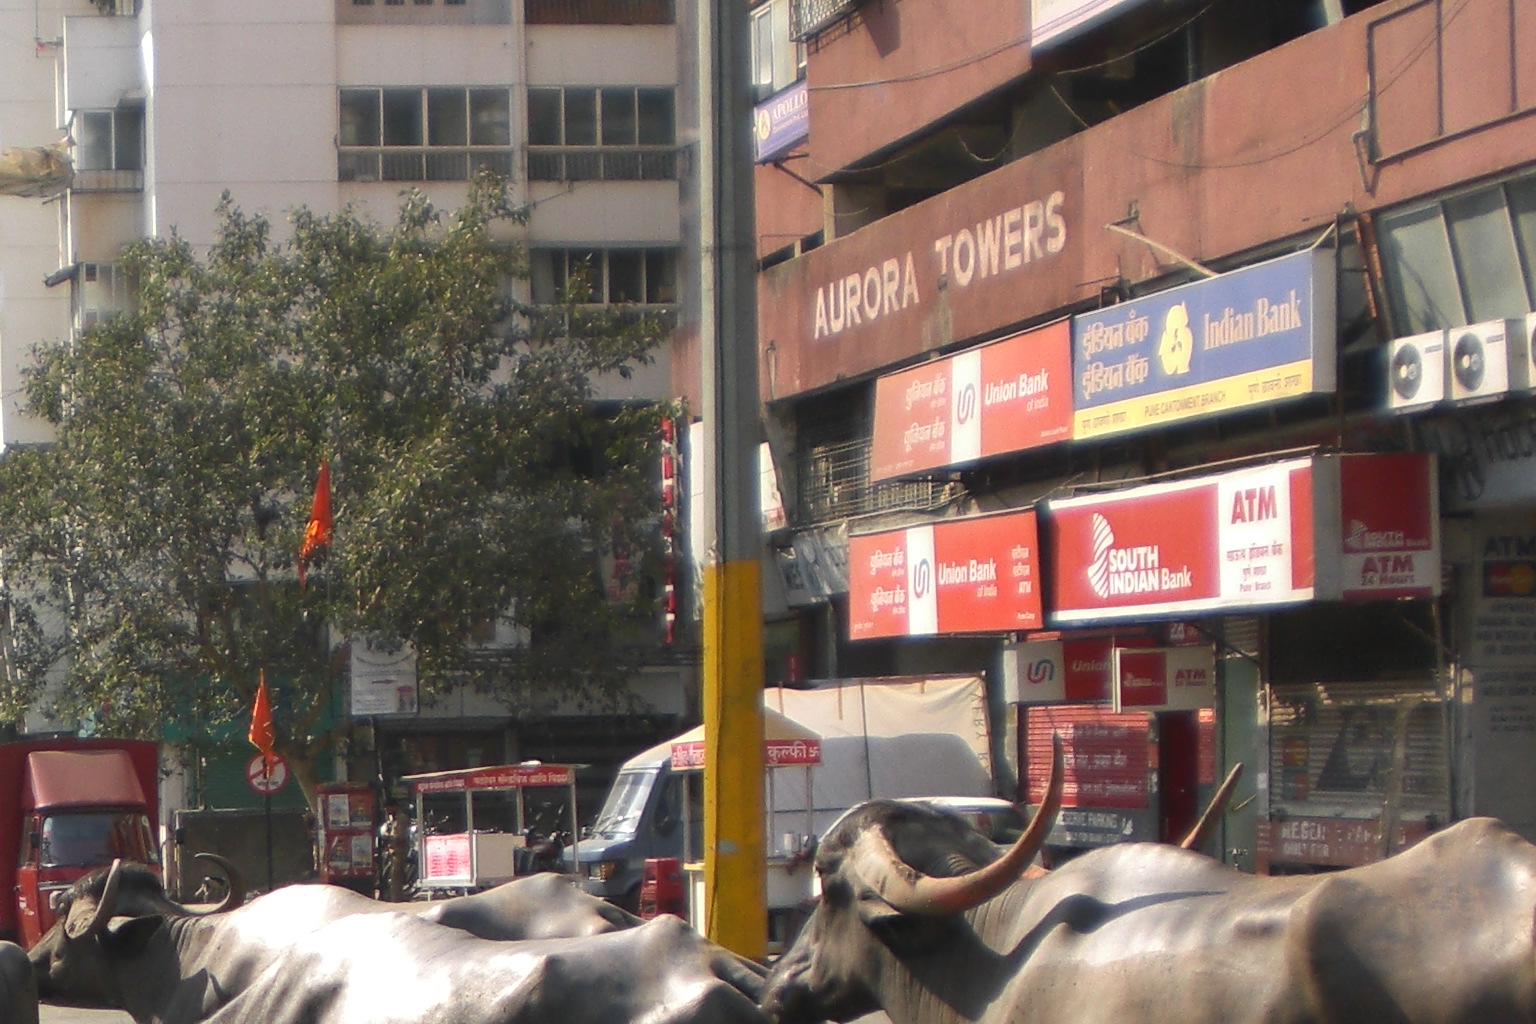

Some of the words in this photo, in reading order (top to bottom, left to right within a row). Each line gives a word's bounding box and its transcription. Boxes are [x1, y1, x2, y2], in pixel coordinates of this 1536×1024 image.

[773, 90, 808, 119] APOLLO
[814, 250, 920, 340] AURORA
[935, 190, 1066, 287] TOWERS
[1204, 306, 1254, 350] Indian
[1256, 289, 1302, 338] Bank
[985, 379, 1017, 406] Union
[1019, 368, 1049, 398] Bank
[1145, 403, 1159, 418] PUNE
[1160, 394, 1200, 415] CANTONMENT
[1201, 389, 1226, 407] BRANCH
[1231, 485, 1277, 525] ATM
[939, 561, 967, 585] Union
[969, 557, 997, 582] Bank
[1109, 545, 1159, 572] SOUTH
[1362, 554, 1415, 573] ATM
[1018, 581, 1032, 594] ATM
[1110, 569, 1159, 595] INDIAN
[1161, 565, 1192, 590] Bank
[1239, 582, 1252, 593] Pune
[1253, 580, 1272, 592] Branch
[1073, 659, 1110, 673] Union
[1175, 669, 1207, 680] ATM
[767, 741, 807, 764] कुल्फी
